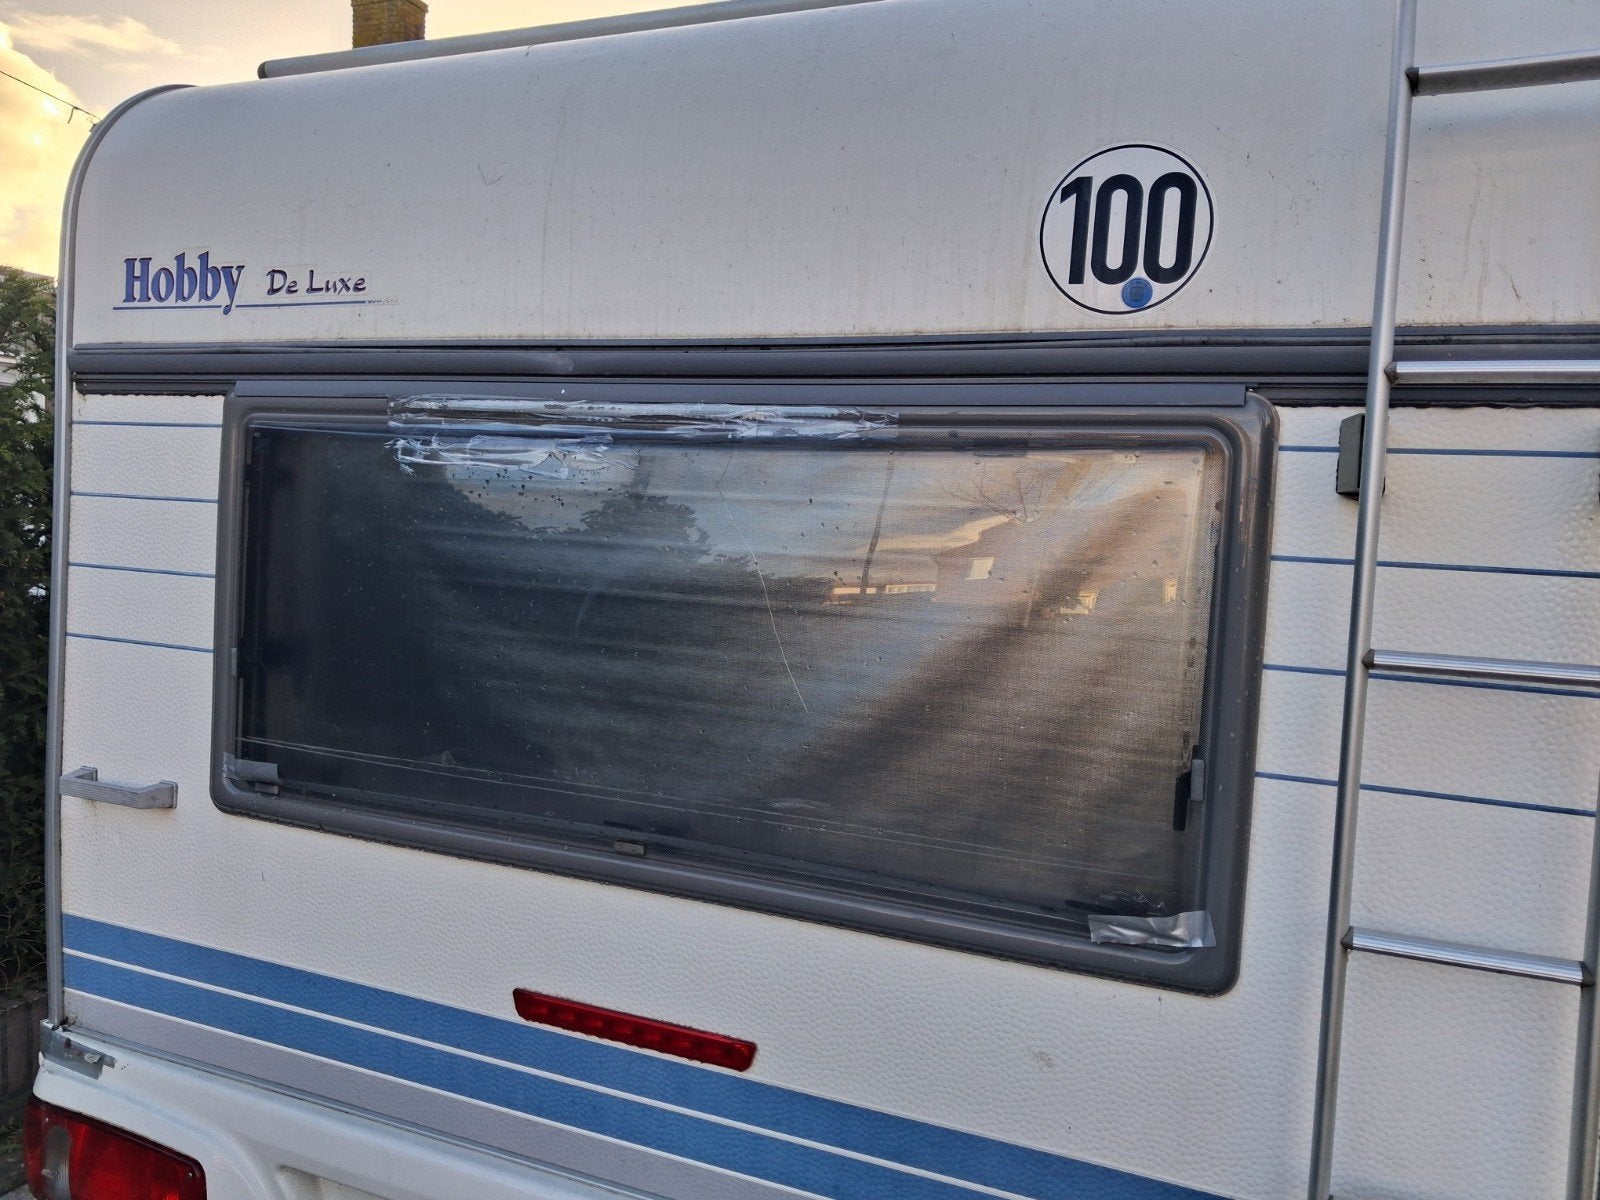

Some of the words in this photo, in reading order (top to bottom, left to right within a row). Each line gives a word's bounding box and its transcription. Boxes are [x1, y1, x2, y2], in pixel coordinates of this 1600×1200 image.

[1060, 171, 1198, 285] 100
[123, 251, 245, 315] Hobby
[266, 268, 299, 296] De
[306, 269, 367, 294] Luxe
